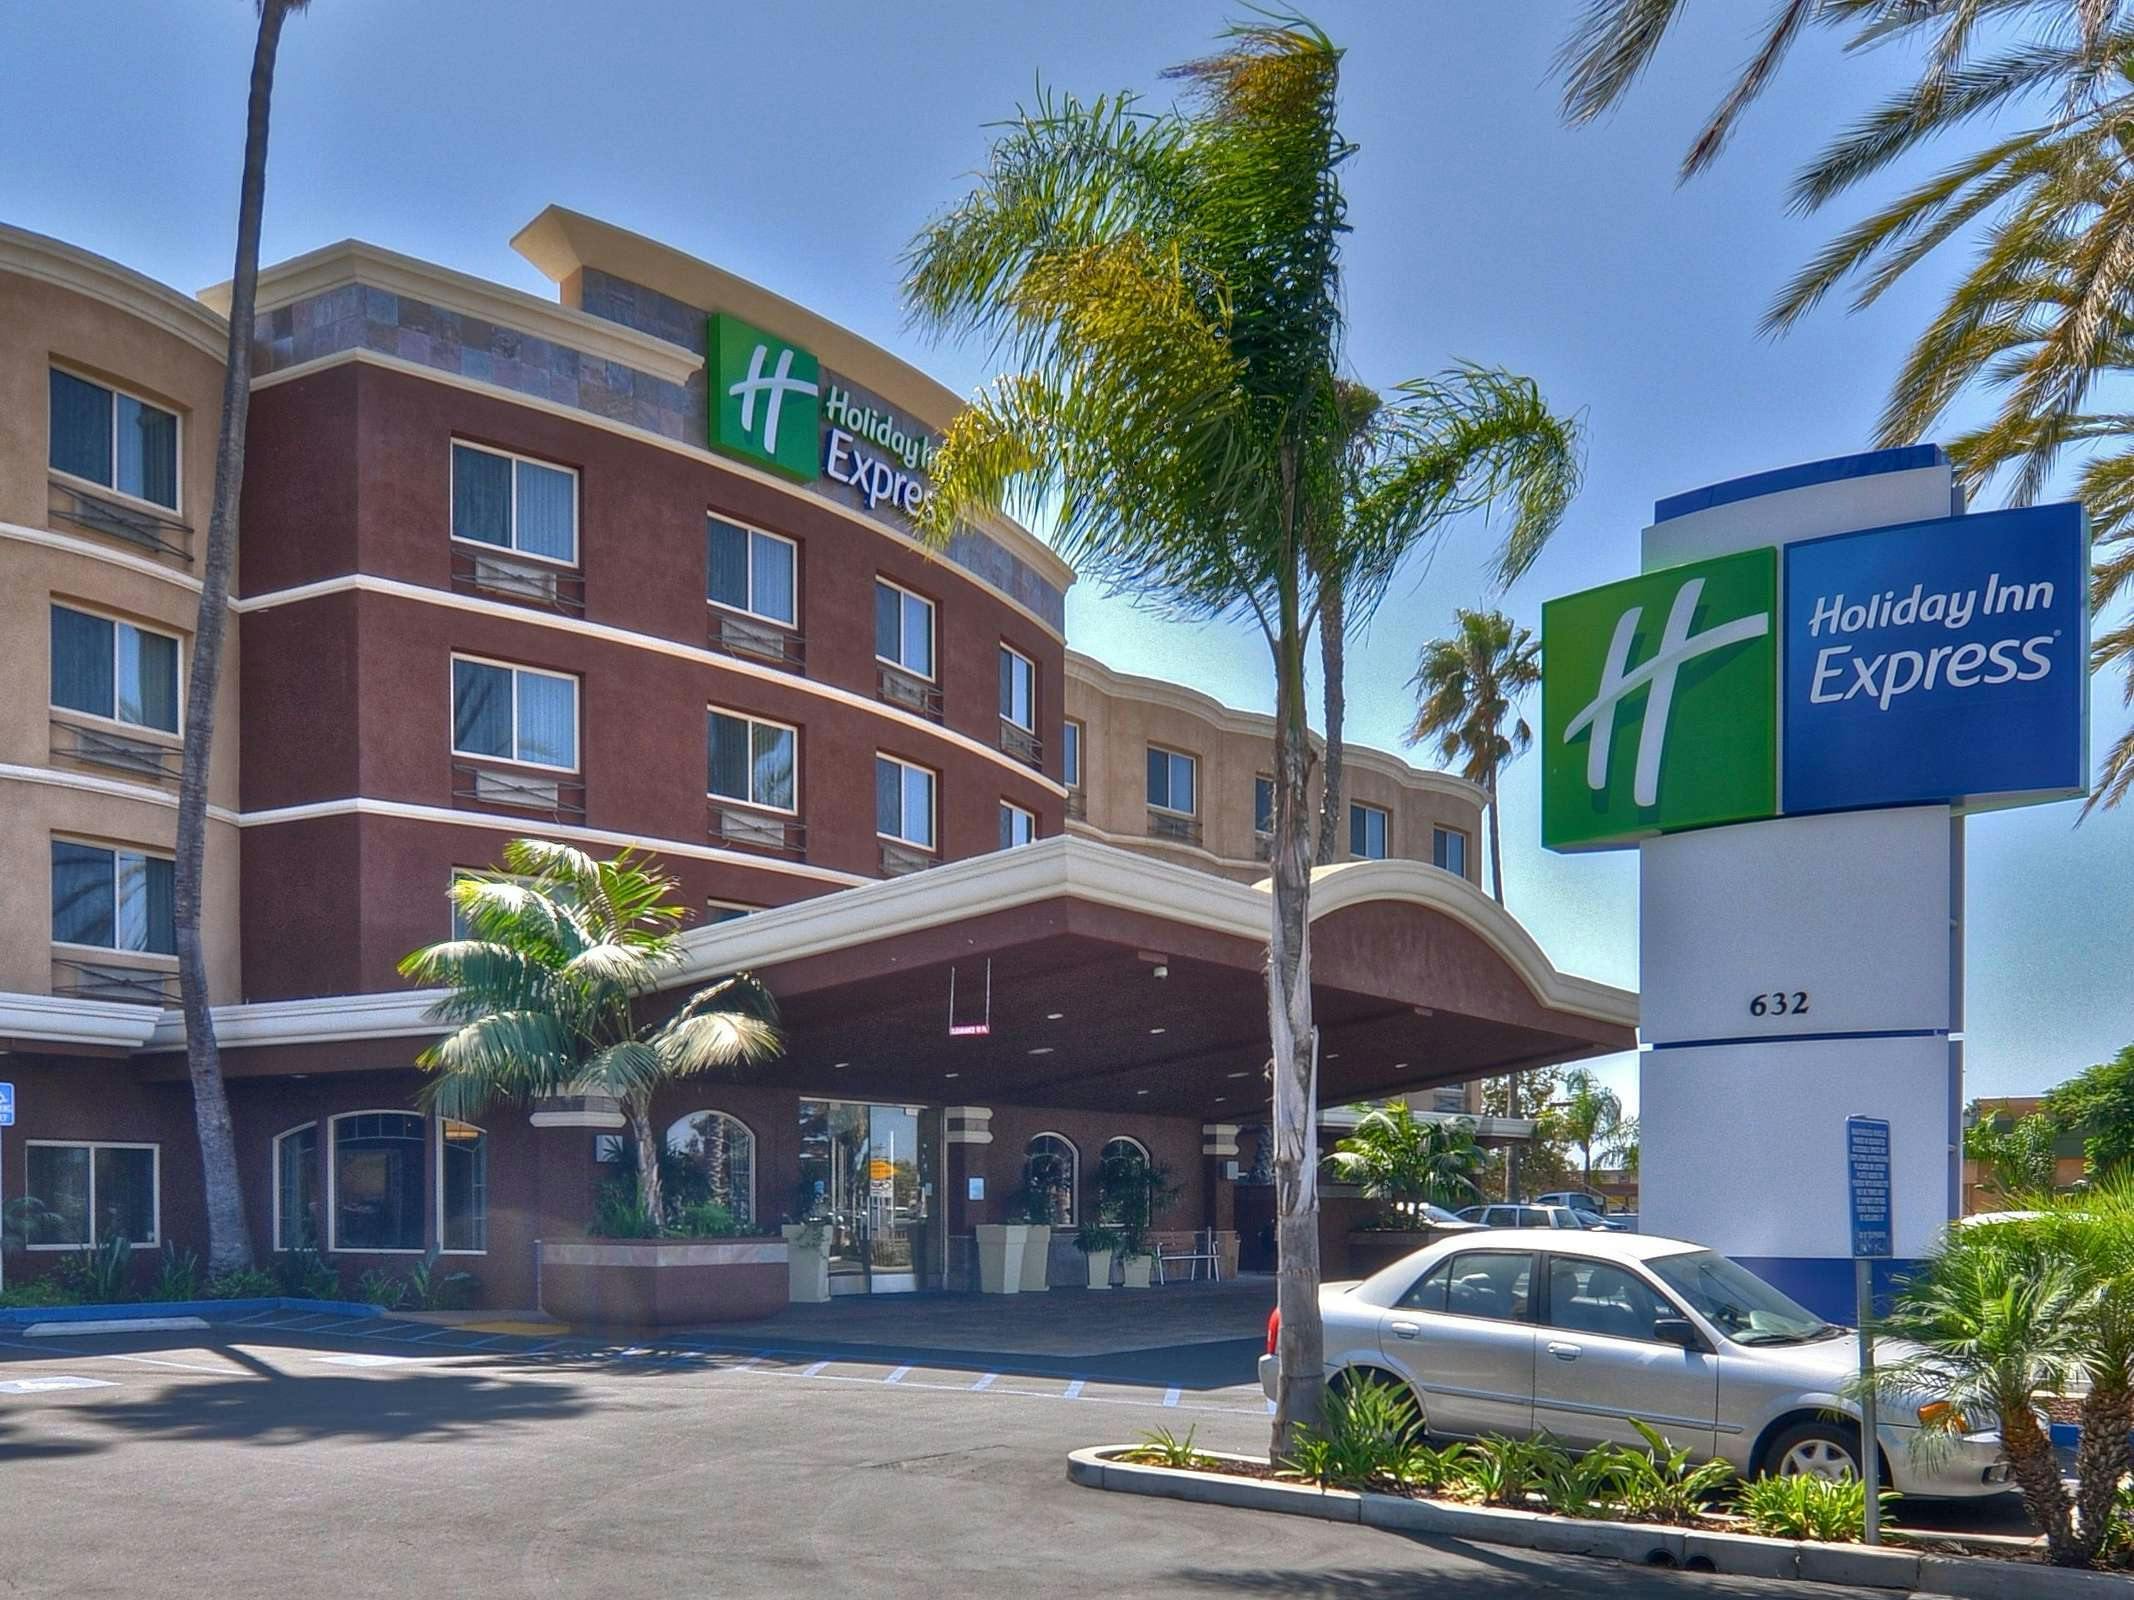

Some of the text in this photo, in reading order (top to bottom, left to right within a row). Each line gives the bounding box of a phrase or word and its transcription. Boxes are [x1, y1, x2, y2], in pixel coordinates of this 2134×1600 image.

[826, 384, 919, 469] Holiday
[827, 427, 929, 517] Expre
[1808, 572, 2055, 638] Holiday Inn
[1809, 635, 2055, 712] Express
[1749, 991, 1809, 1017] 632
